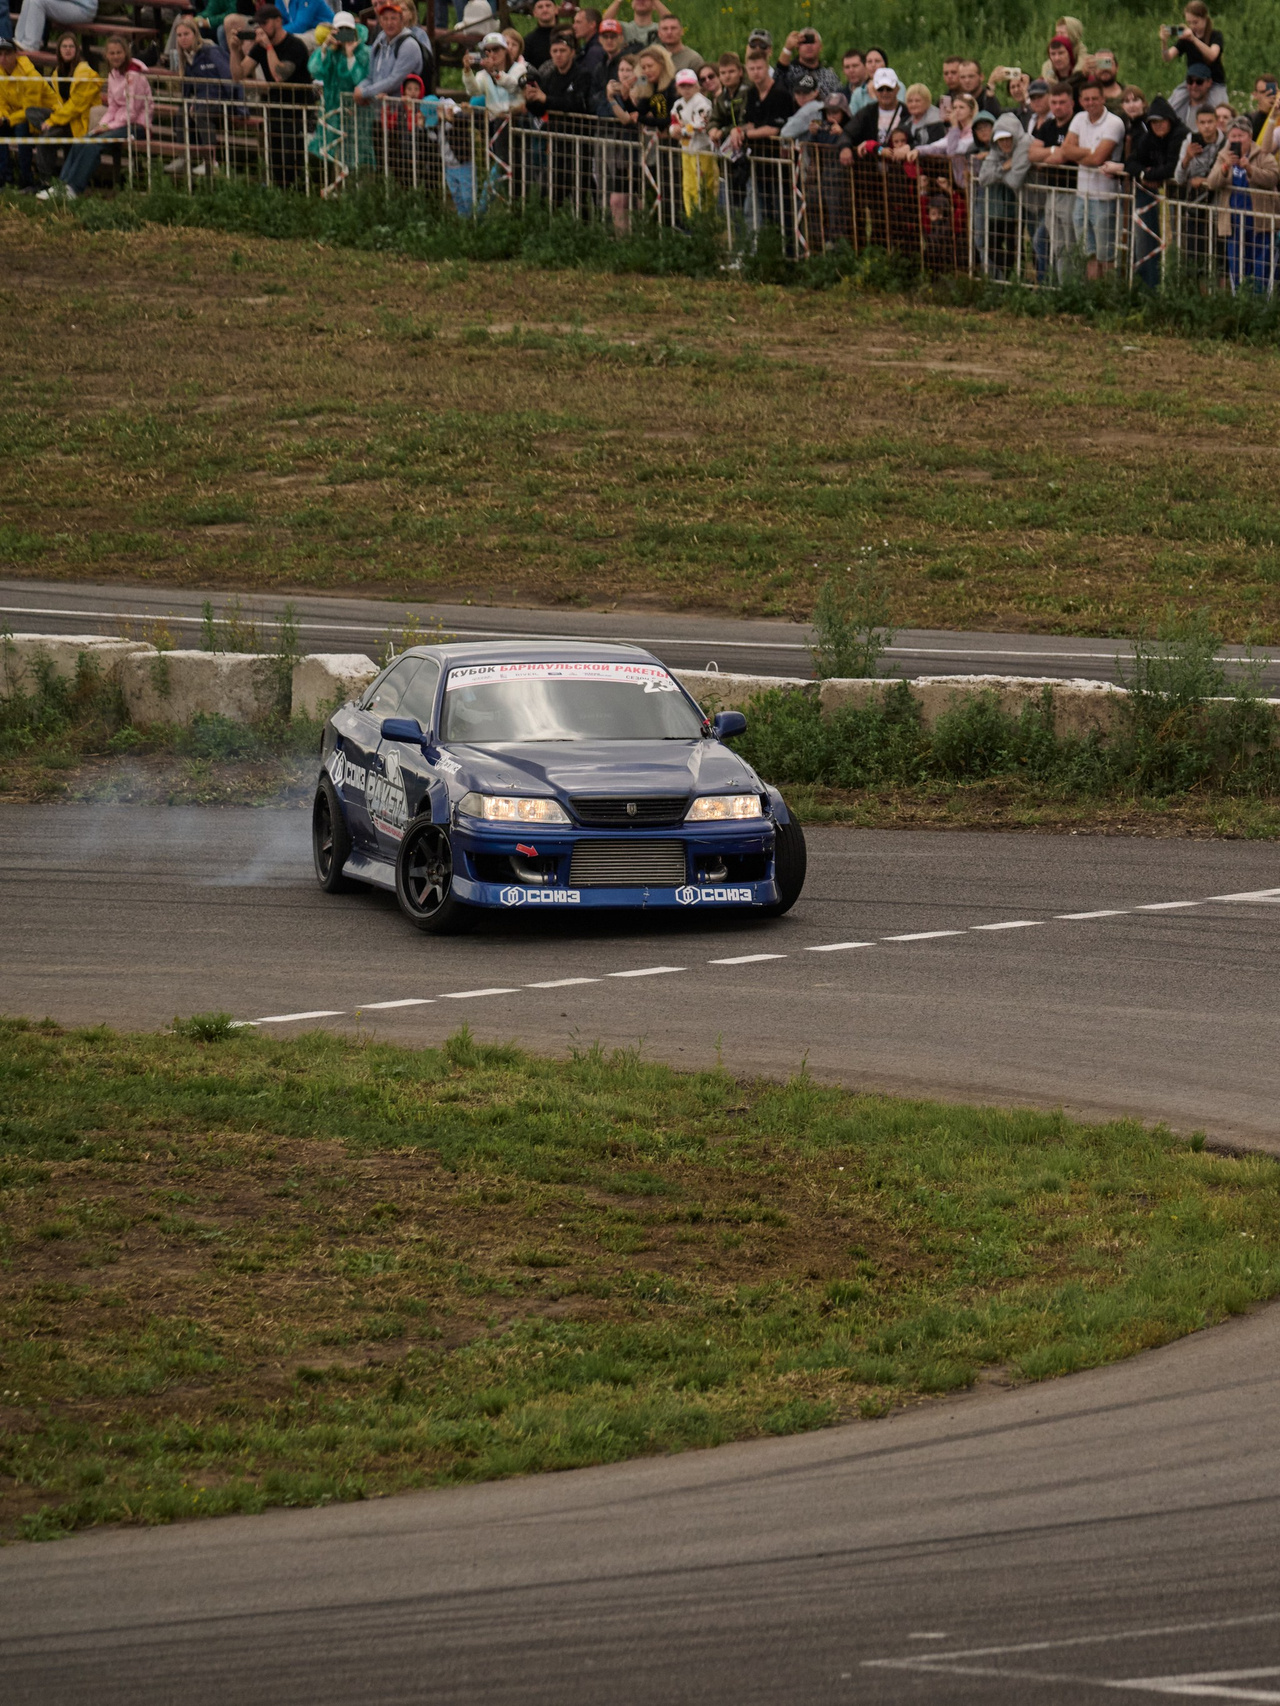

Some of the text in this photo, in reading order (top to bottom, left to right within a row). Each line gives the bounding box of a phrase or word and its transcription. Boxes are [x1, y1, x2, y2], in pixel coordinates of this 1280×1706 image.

[451, 666, 496, 679] КУБОК
[500, 663, 610, 672] БАРНАУЛЬСКОЙ
[615, 665, 670, 679] РАКЕТЫ
[527, 890, 580, 903] СОЮЗ
[701, 889, 752, 902] СОЮЗ
